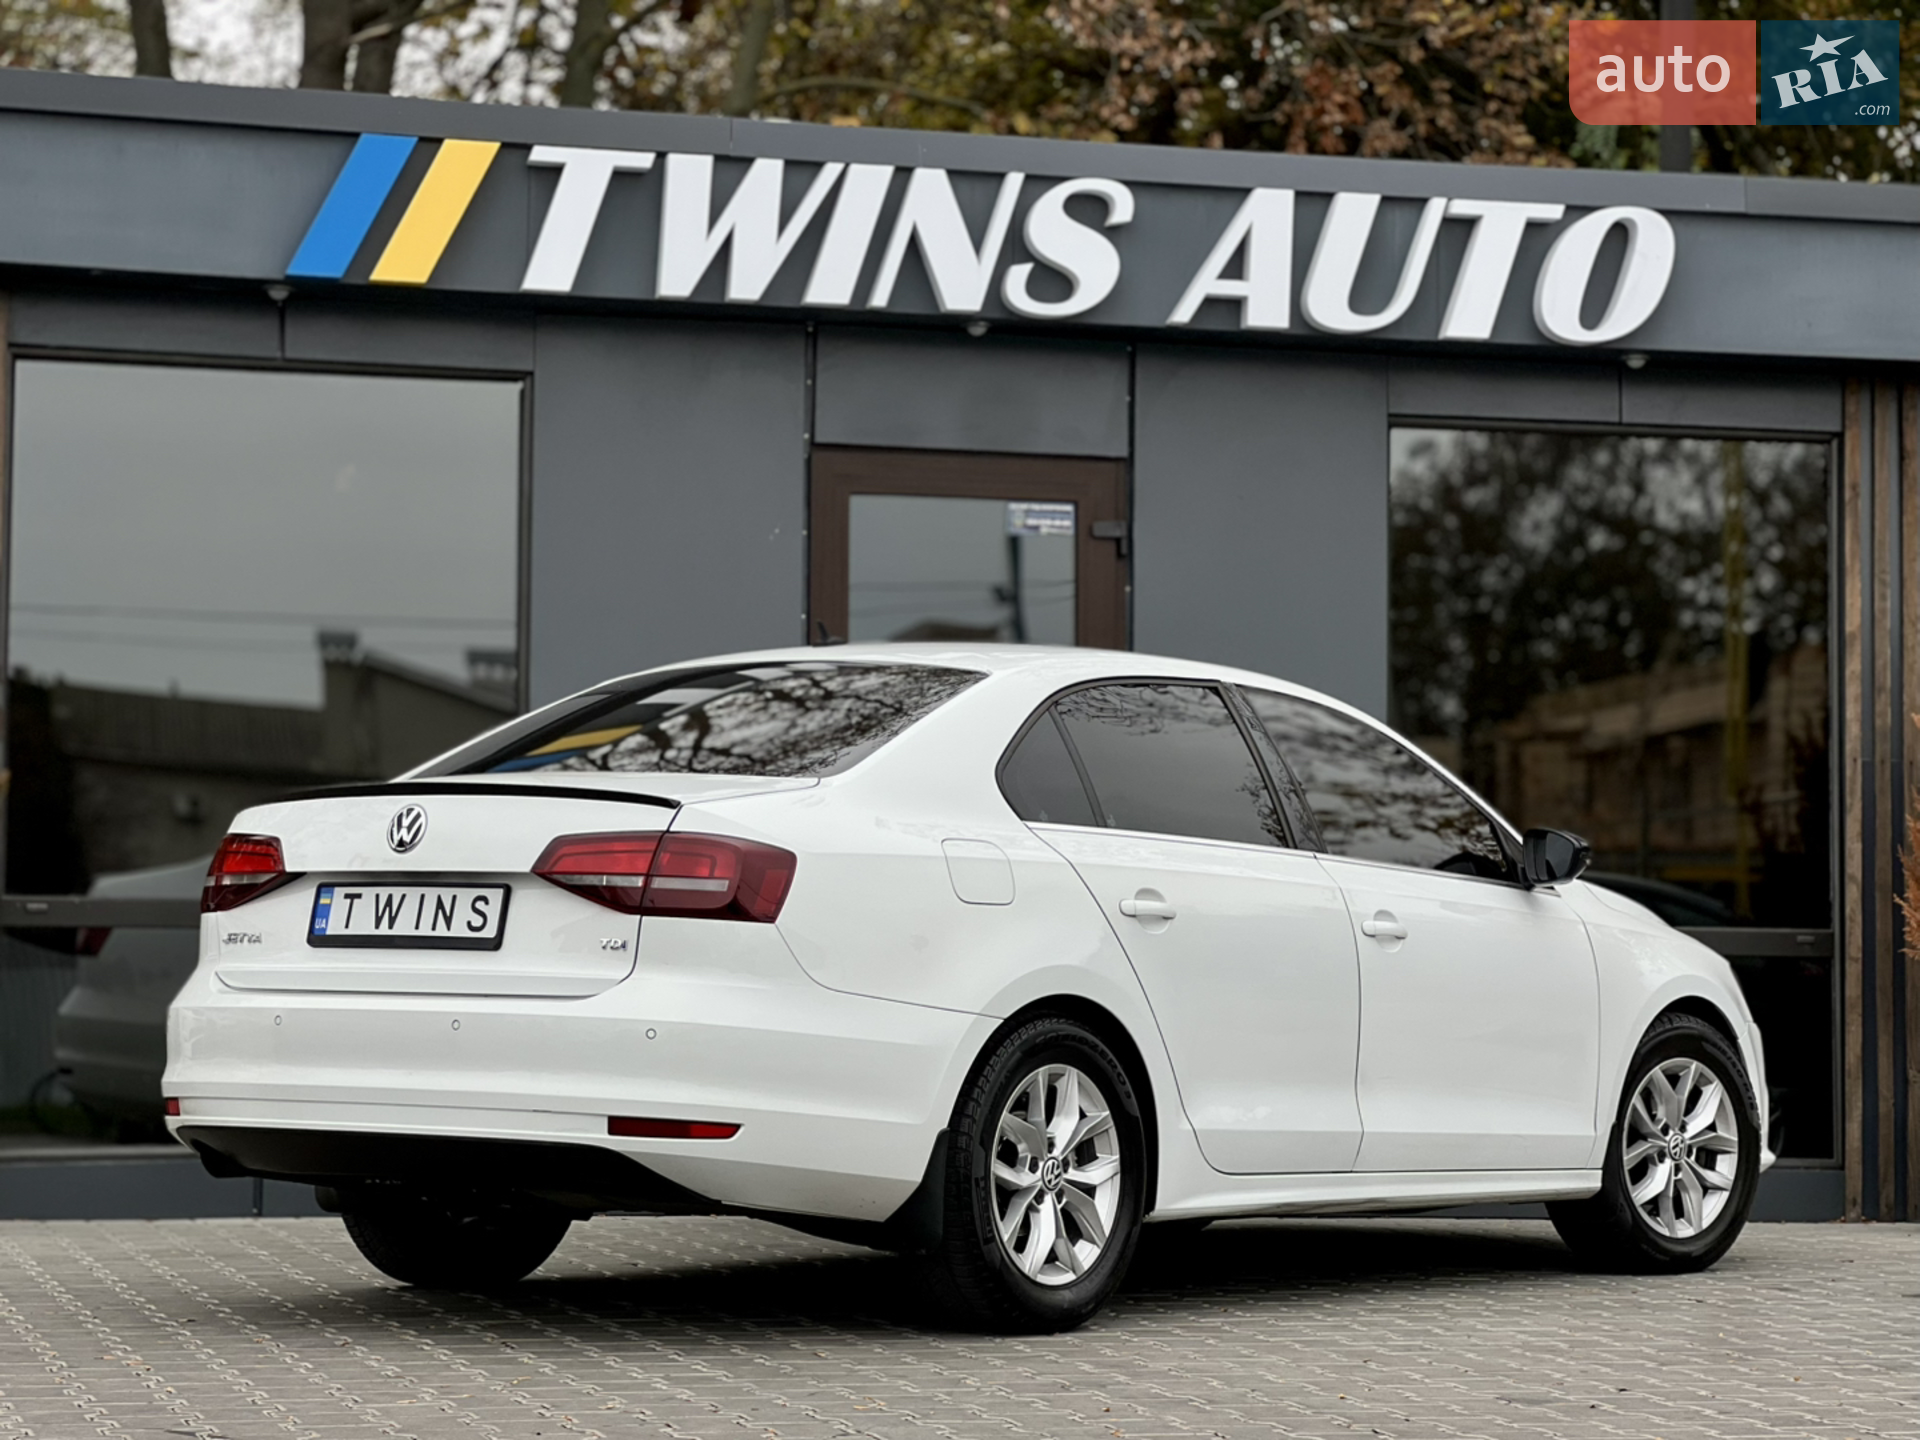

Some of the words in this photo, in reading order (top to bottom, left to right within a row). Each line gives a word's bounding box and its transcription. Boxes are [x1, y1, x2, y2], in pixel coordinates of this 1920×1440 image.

[519, 144, 1136, 320] TWINS
[1165, 187, 1677, 347] AUTO
[314, 918, 327, 930] UA
[343, 892, 490, 933] TWINS
